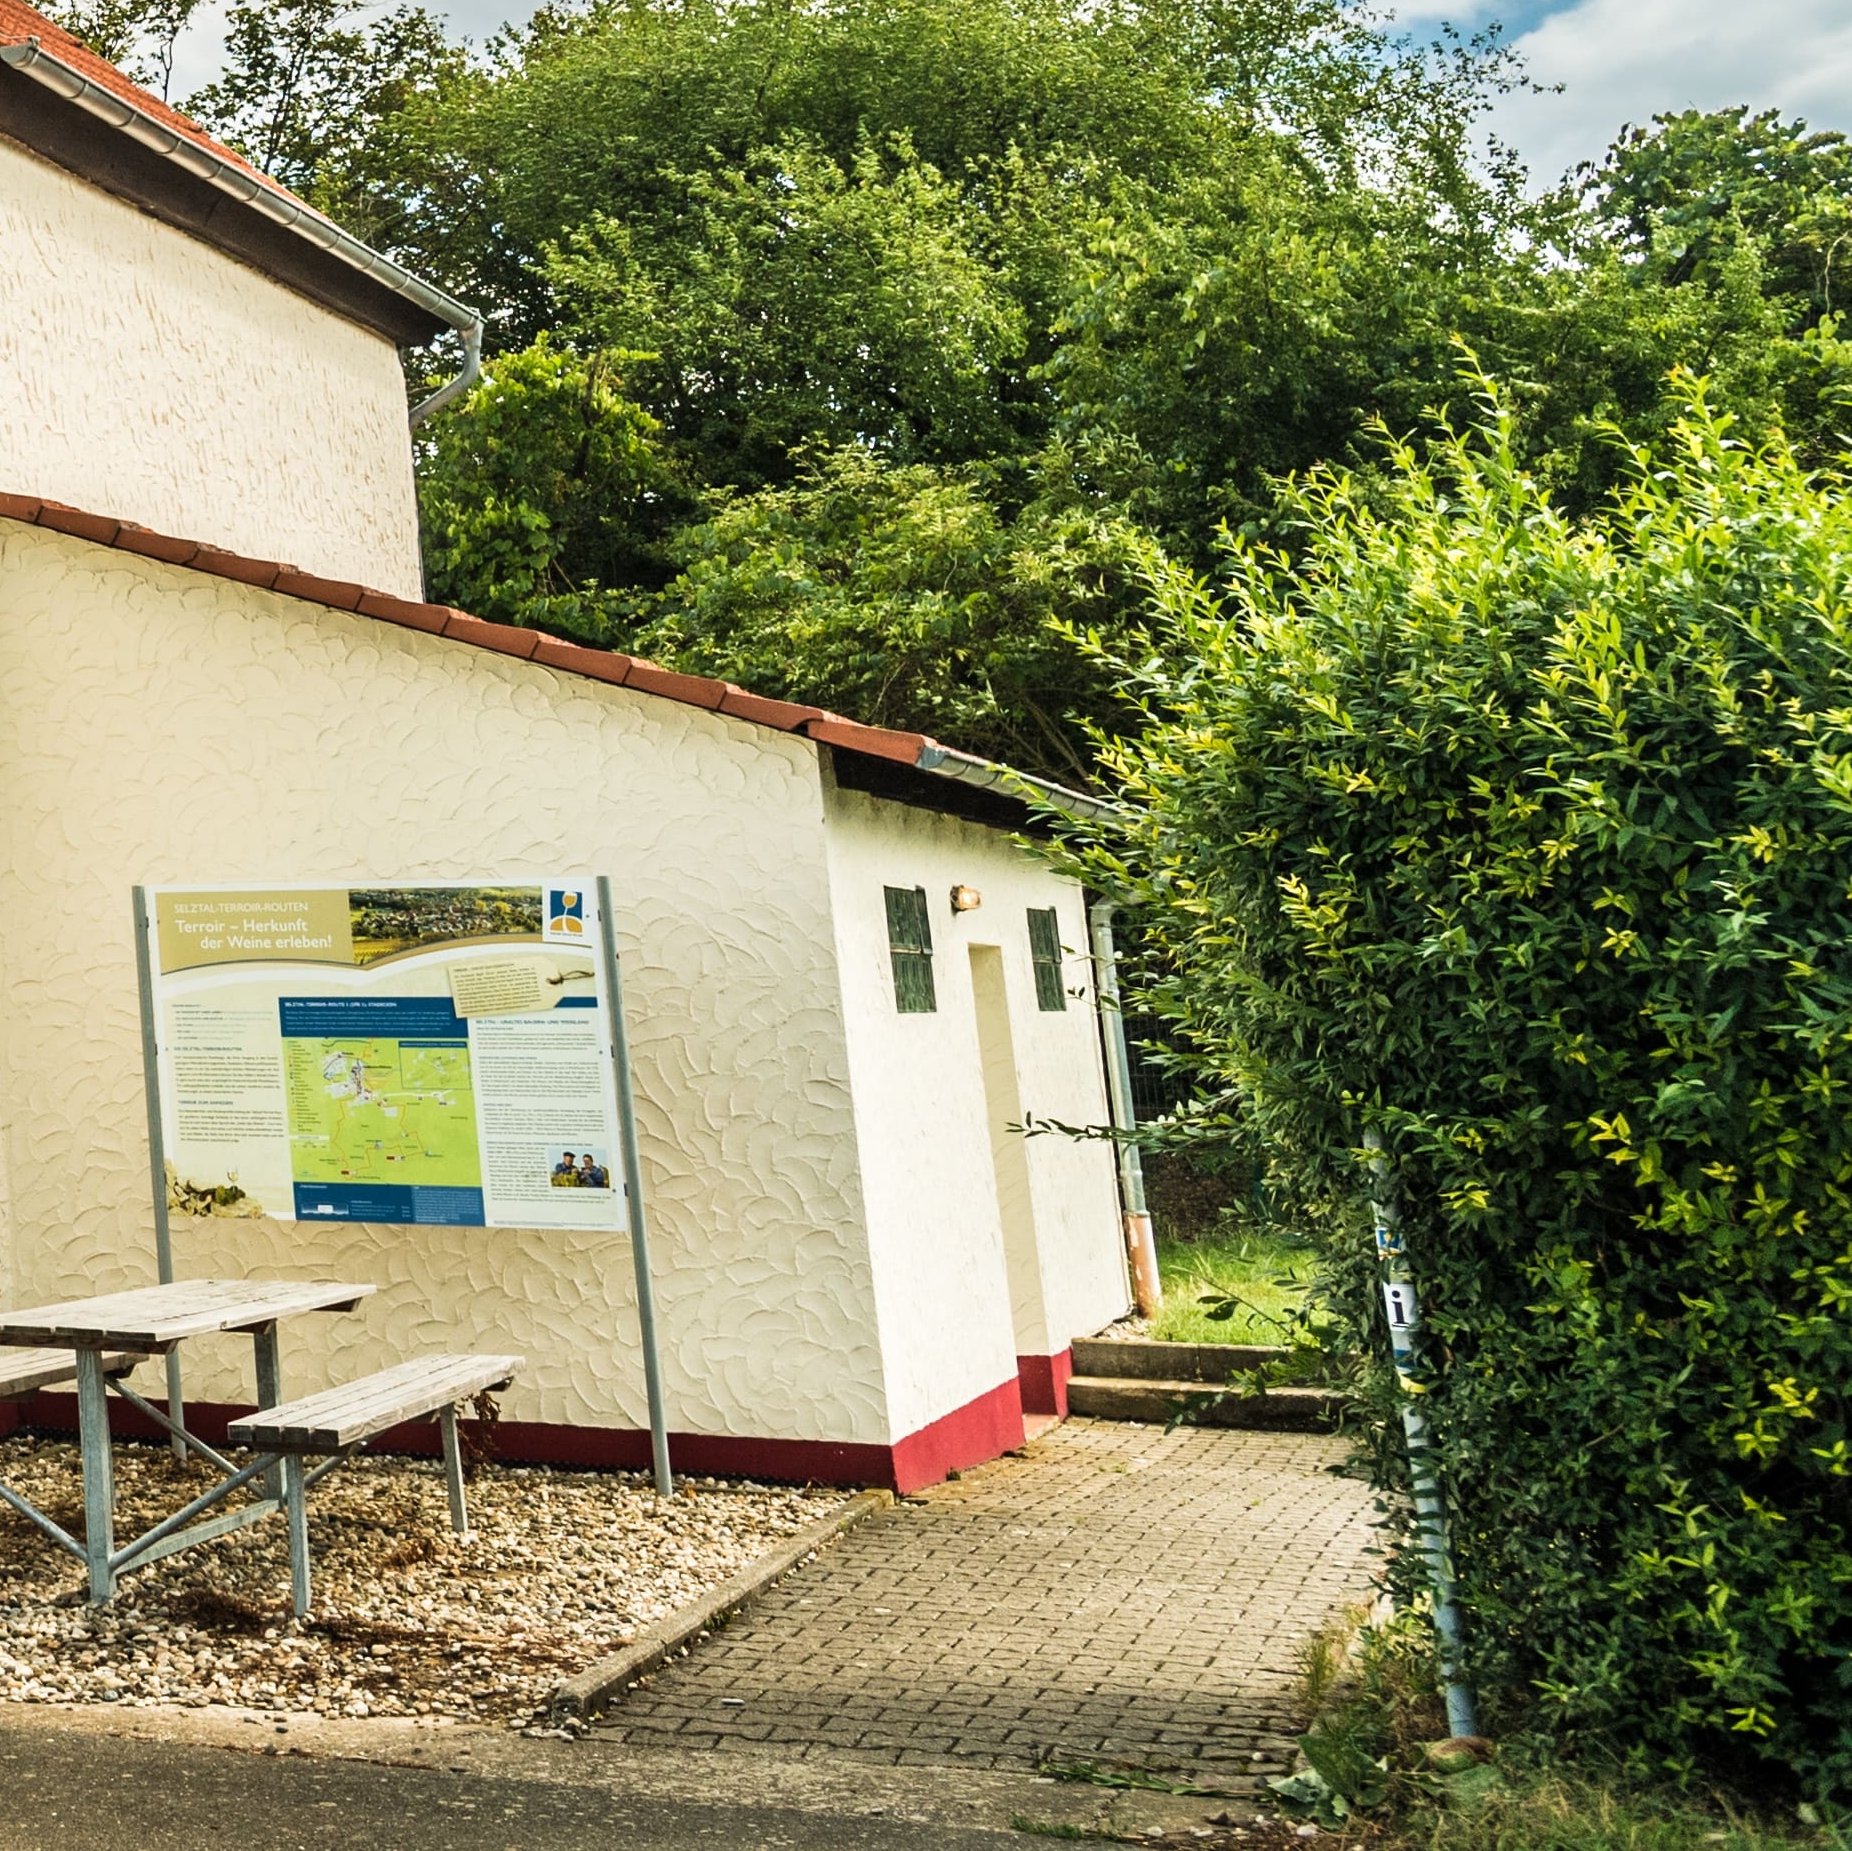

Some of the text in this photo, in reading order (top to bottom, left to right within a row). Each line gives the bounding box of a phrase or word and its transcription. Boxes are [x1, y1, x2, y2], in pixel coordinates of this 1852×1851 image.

[174, 902, 309, 914] SELZTAL-TERROIR-ROUTEN
[175, 919, 226, 933] Terroir
[243, 917, 308, 933] Herkunft
[200, 934, 333, 949] der Weine erleben!
